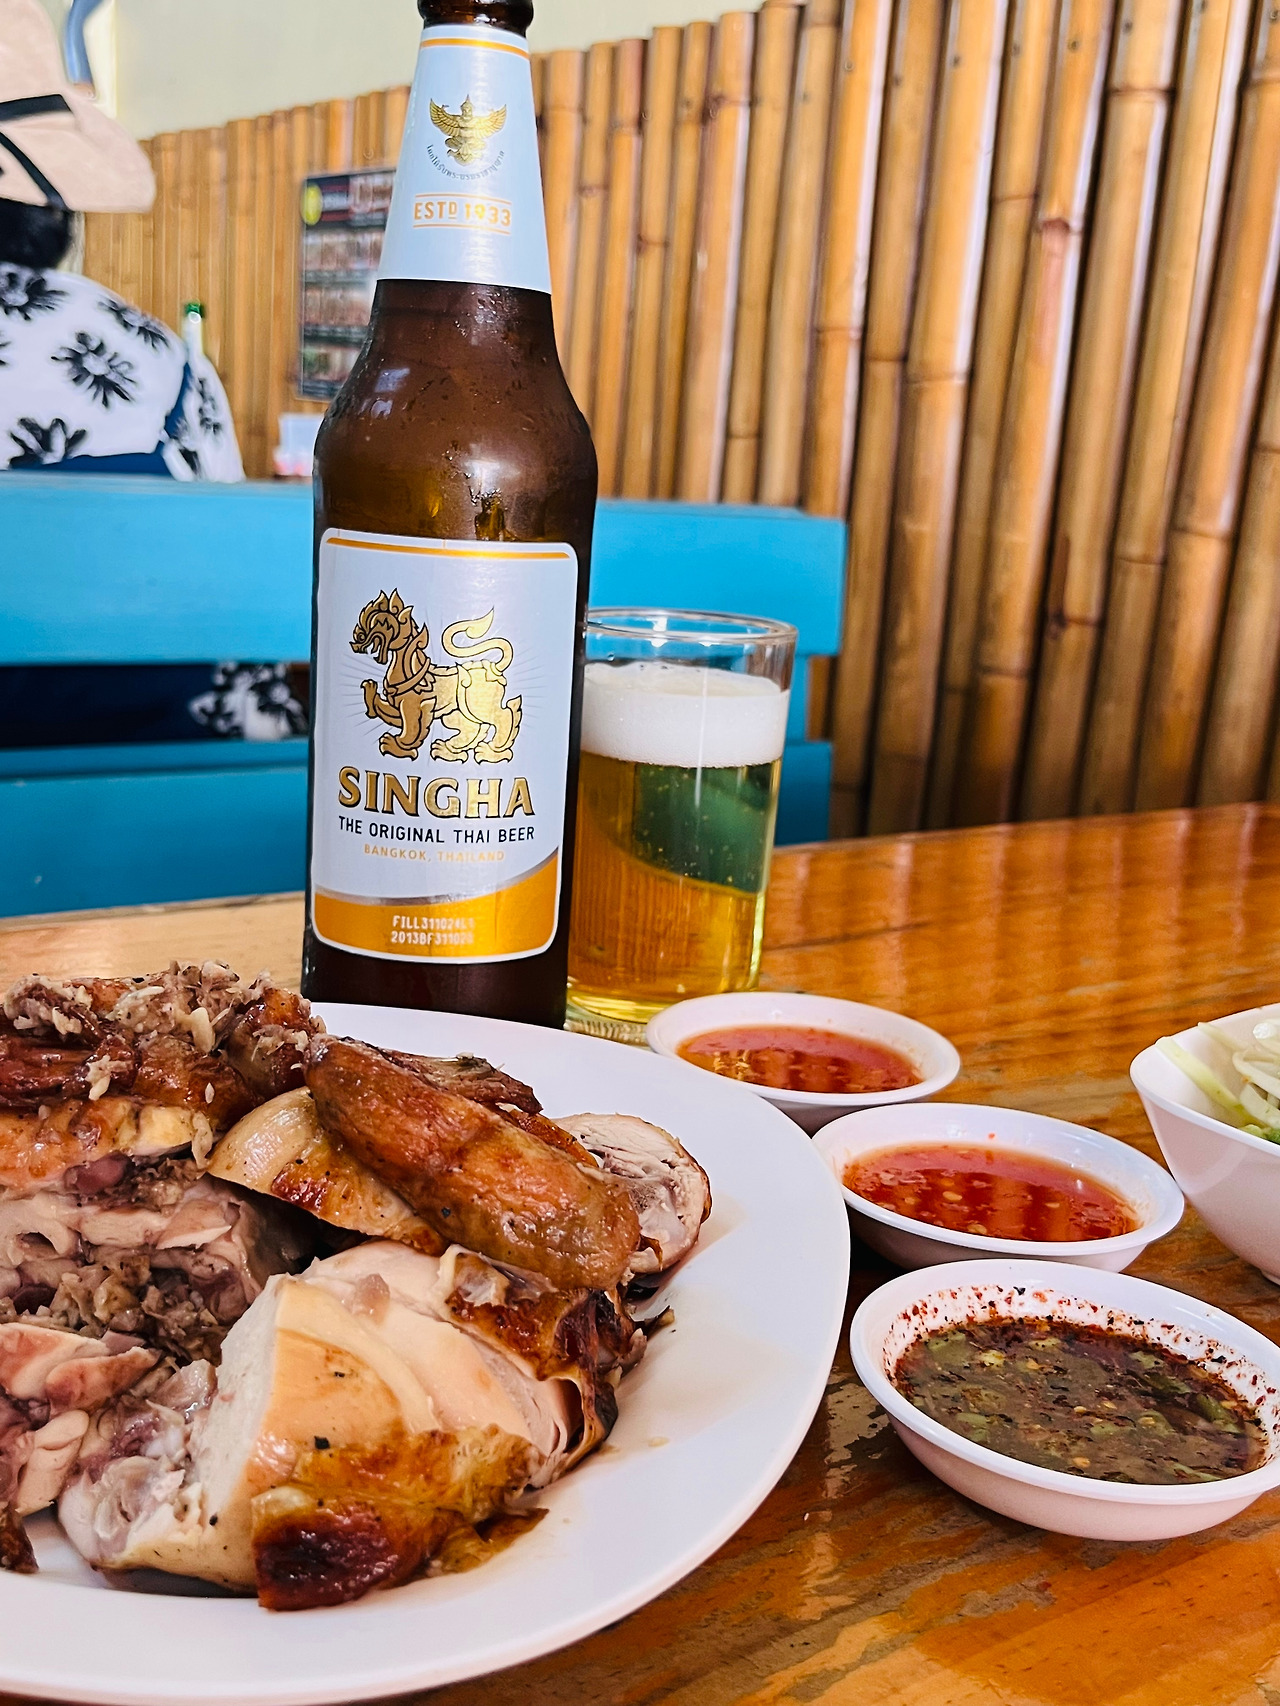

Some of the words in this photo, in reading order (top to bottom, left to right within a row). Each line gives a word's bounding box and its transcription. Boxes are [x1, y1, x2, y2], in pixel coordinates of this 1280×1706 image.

[414, 202, 457, 220] ESTD
[465, 204, 511, 226] 1933
[338, 766, 535, 819] SINGHA
[338, 815, 363, 839] THE
[369, 822, 445, 843] ORIGINAL
[453, 829, 490, 844] THAI
[498, 827, 535, 843] BEER
[364, 843, 431, 862] BANGKOK,
[437, 850, 505, 862] THAILAND
